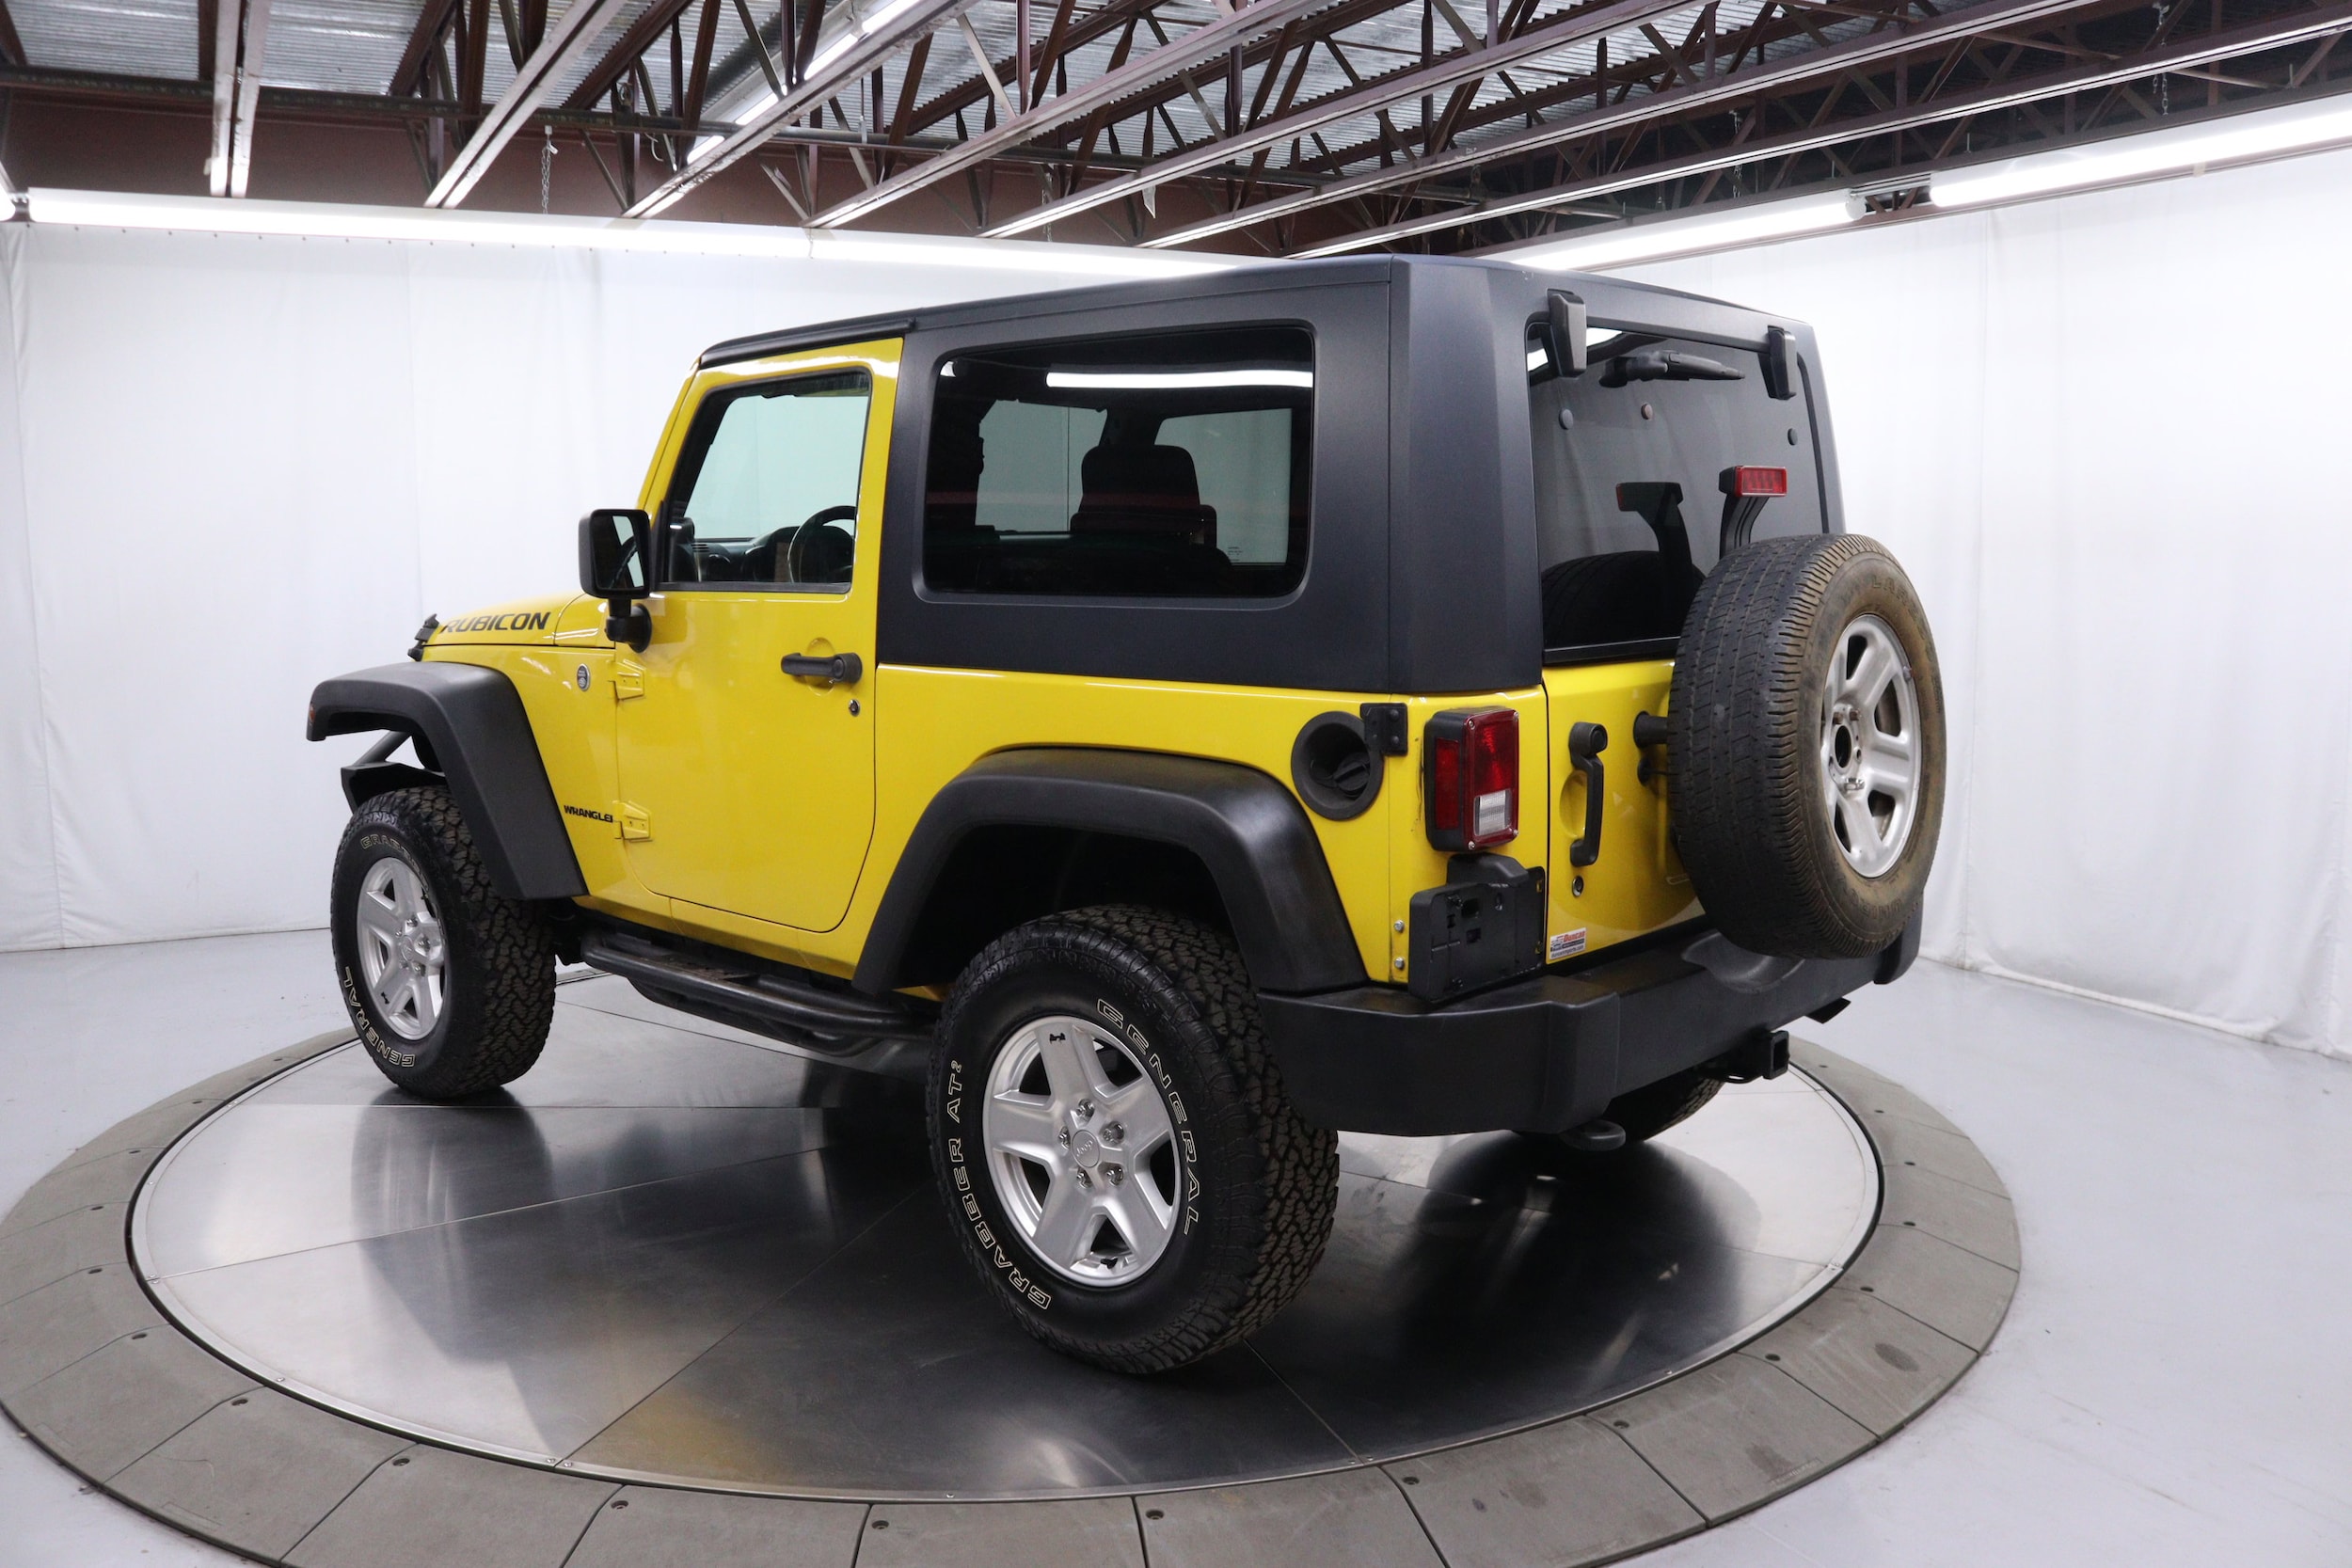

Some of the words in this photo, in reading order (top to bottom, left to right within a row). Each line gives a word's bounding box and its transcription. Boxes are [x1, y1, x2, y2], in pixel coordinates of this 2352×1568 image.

[440, 611, 551, 633] RUBICON
[344, 966, 416, 1069] GENERAL
[1096, 998, 1201, 1236] GENERAL
[948, 1137, 1052, 1310] GRABBER
